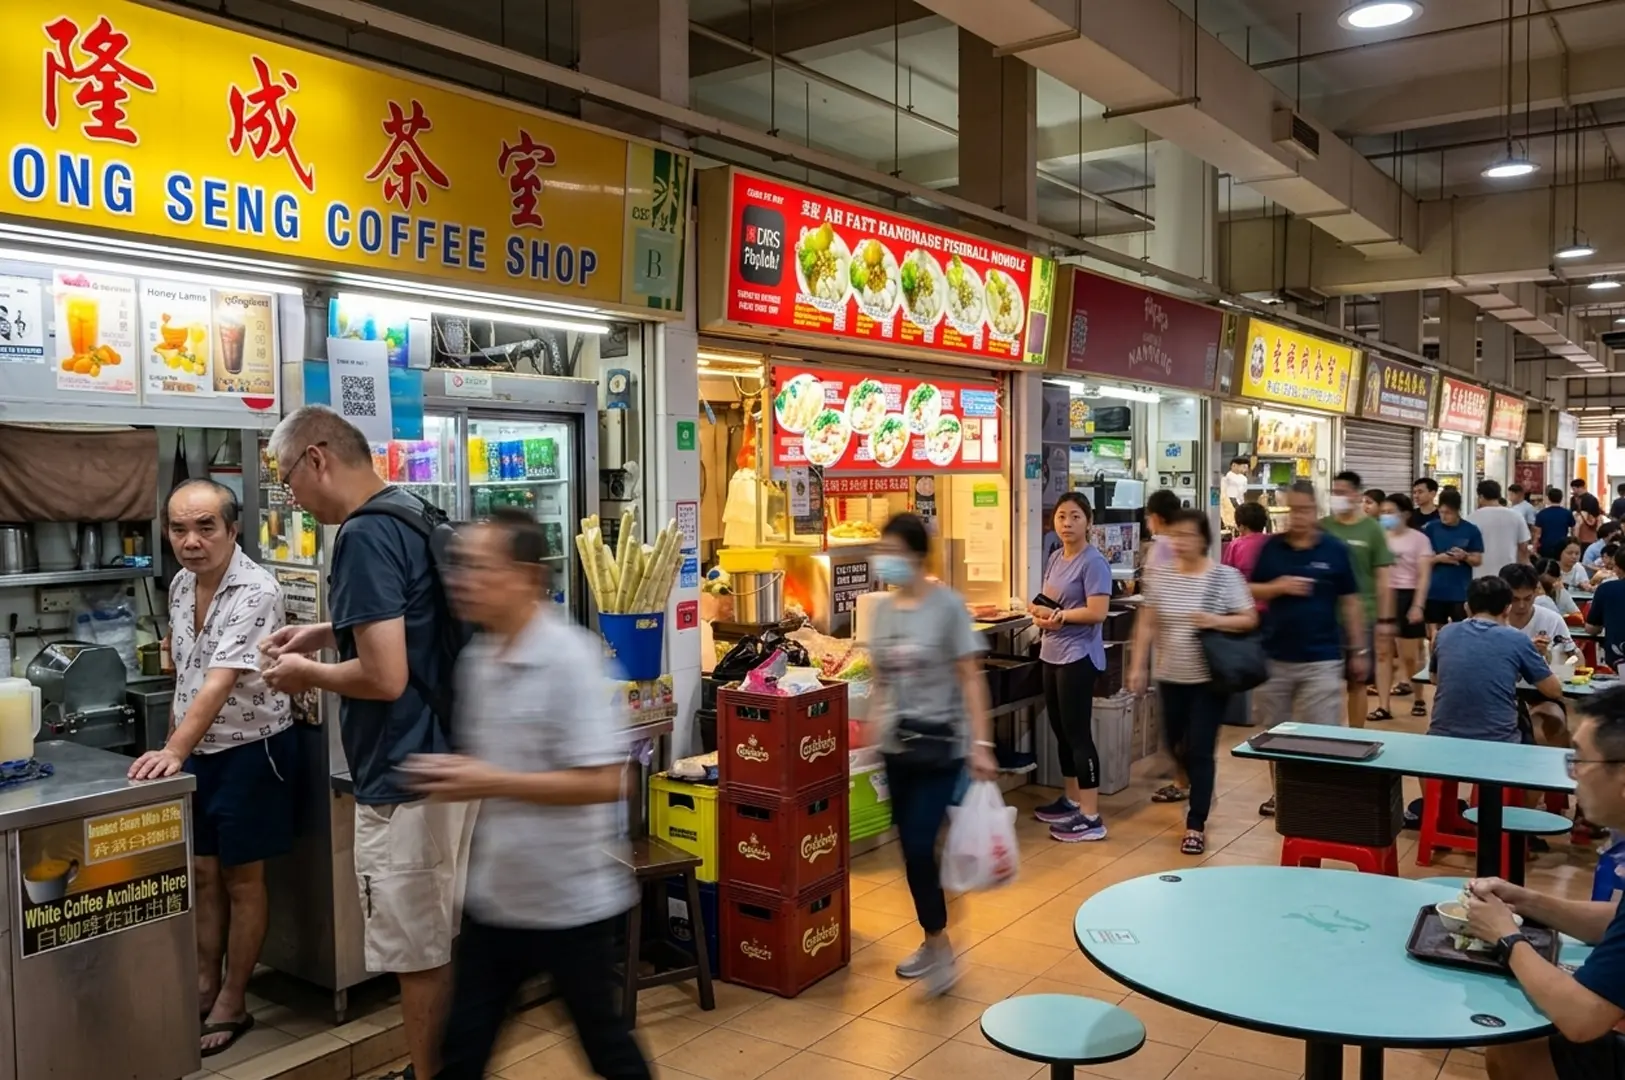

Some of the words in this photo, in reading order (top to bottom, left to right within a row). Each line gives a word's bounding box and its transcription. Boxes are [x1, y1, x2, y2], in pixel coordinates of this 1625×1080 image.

[44, 16, 557, 228] 隆成茶室
[12, 146, 134, 214] ONG
[166, 174, 300, 240] SENG
[326, 202, 486, 270] COFFEE
[505, 235, 597, 286] SHOP
[646, 248, 662, 279] B
[147, 288, 178, 301] Honey
[25, 904, 61, 930] White
[161, 874, 187, 893] Here
